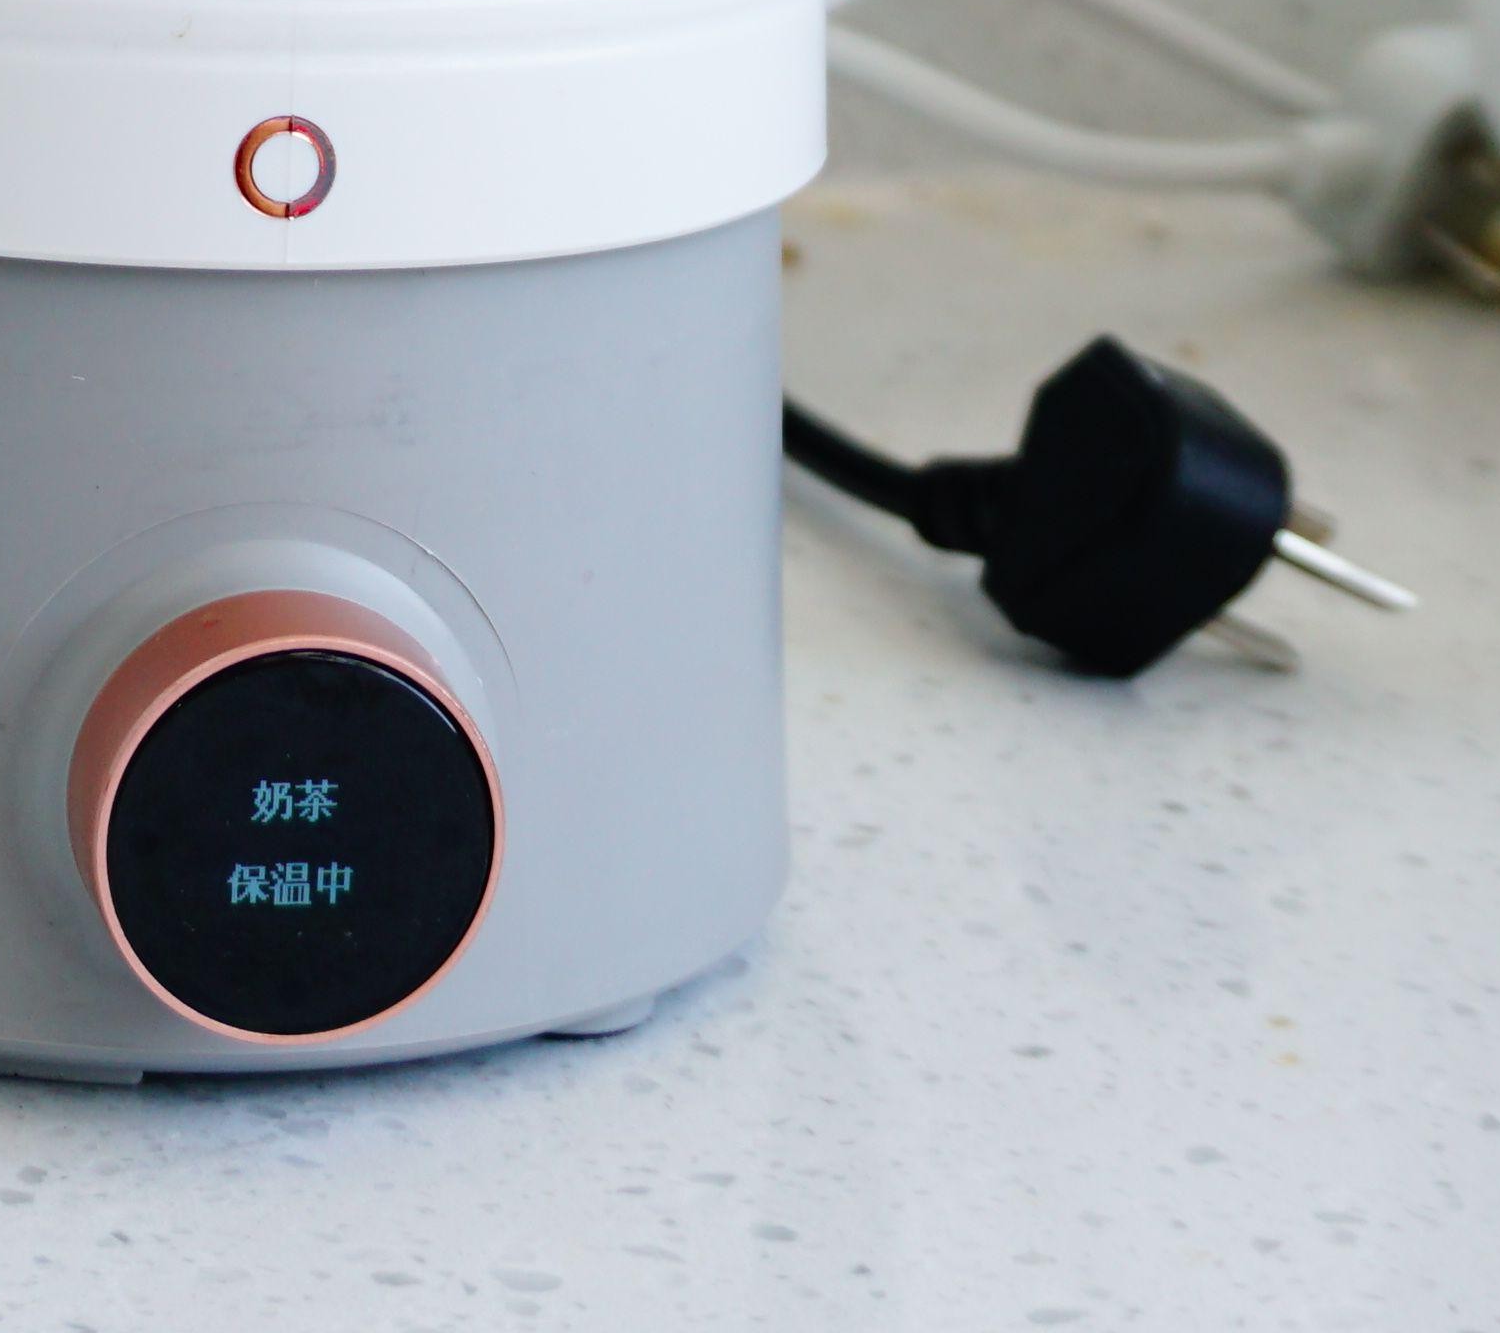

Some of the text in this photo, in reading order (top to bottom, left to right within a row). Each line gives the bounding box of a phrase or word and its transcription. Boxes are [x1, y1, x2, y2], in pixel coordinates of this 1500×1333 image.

[250, 778, 339, 824] 奶茶
[227, 860, 355, 906] 保温中
